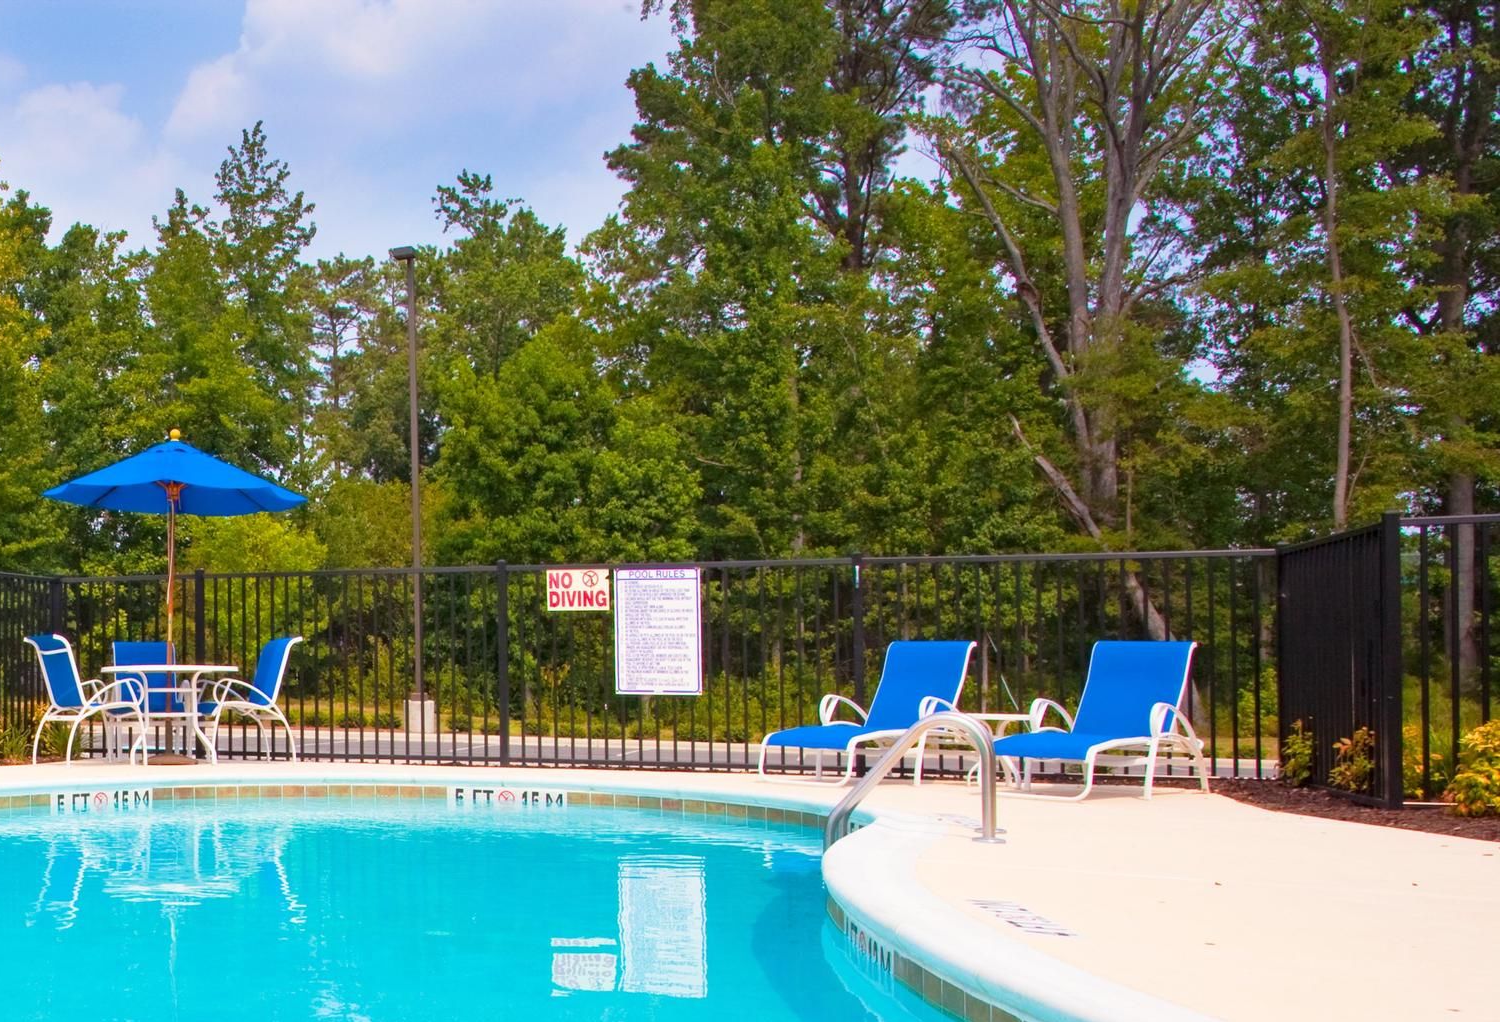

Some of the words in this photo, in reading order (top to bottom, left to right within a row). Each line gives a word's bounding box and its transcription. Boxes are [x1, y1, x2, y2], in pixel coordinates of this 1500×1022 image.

[548, 572, 573, 589] NO
[629, 570, 653, 579] POOL
[656, 569, 686, 578] RULES
[549, 590, 607, 608] DIVING
